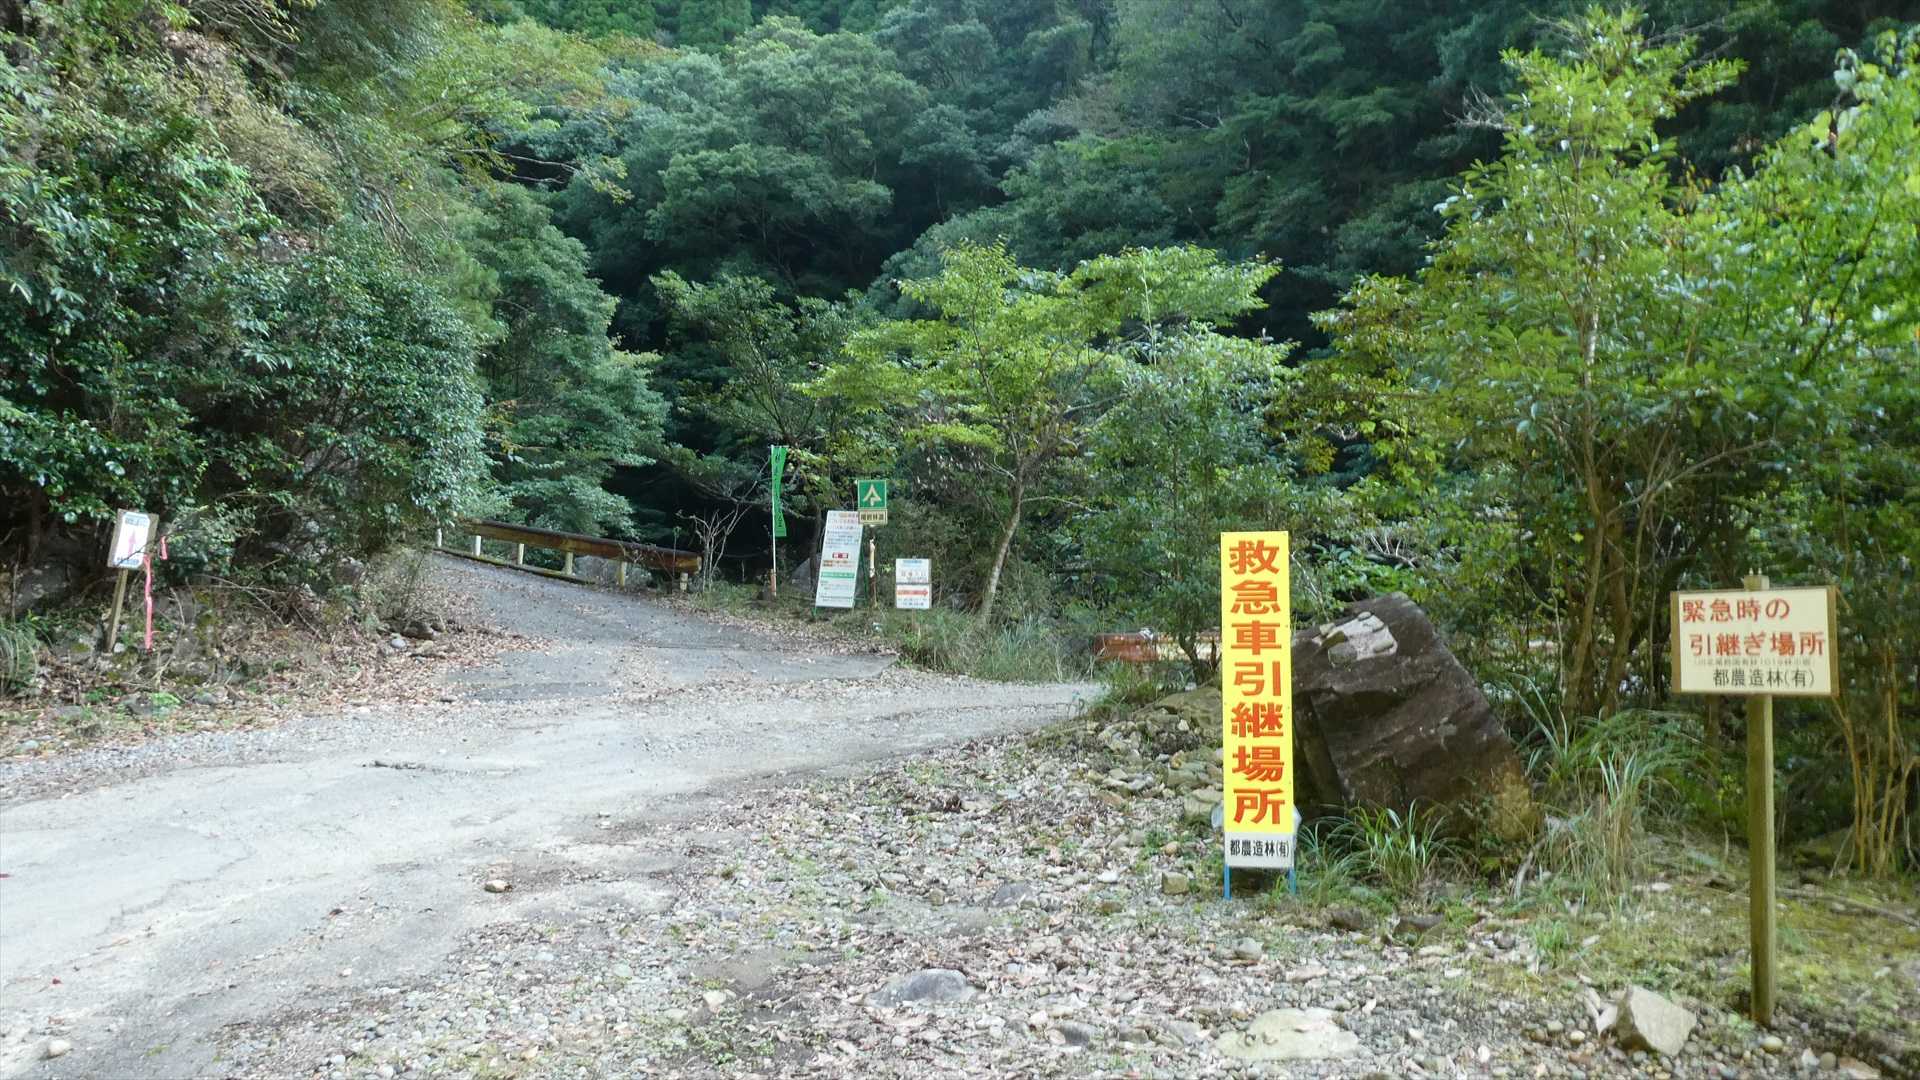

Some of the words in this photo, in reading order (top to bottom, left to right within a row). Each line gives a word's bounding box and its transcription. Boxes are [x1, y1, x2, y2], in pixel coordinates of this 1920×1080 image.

[1682, 598, 1790, 622] 緊急時の
[1689, 630, 1825, 656] 引継ぎ場所
[1229, 540, 1285, 825] 救急車引継場所
[1713, 668, 1815, 688] 都農造林(有)
[1230, 839, 1290, 857] 都農造林(有)
